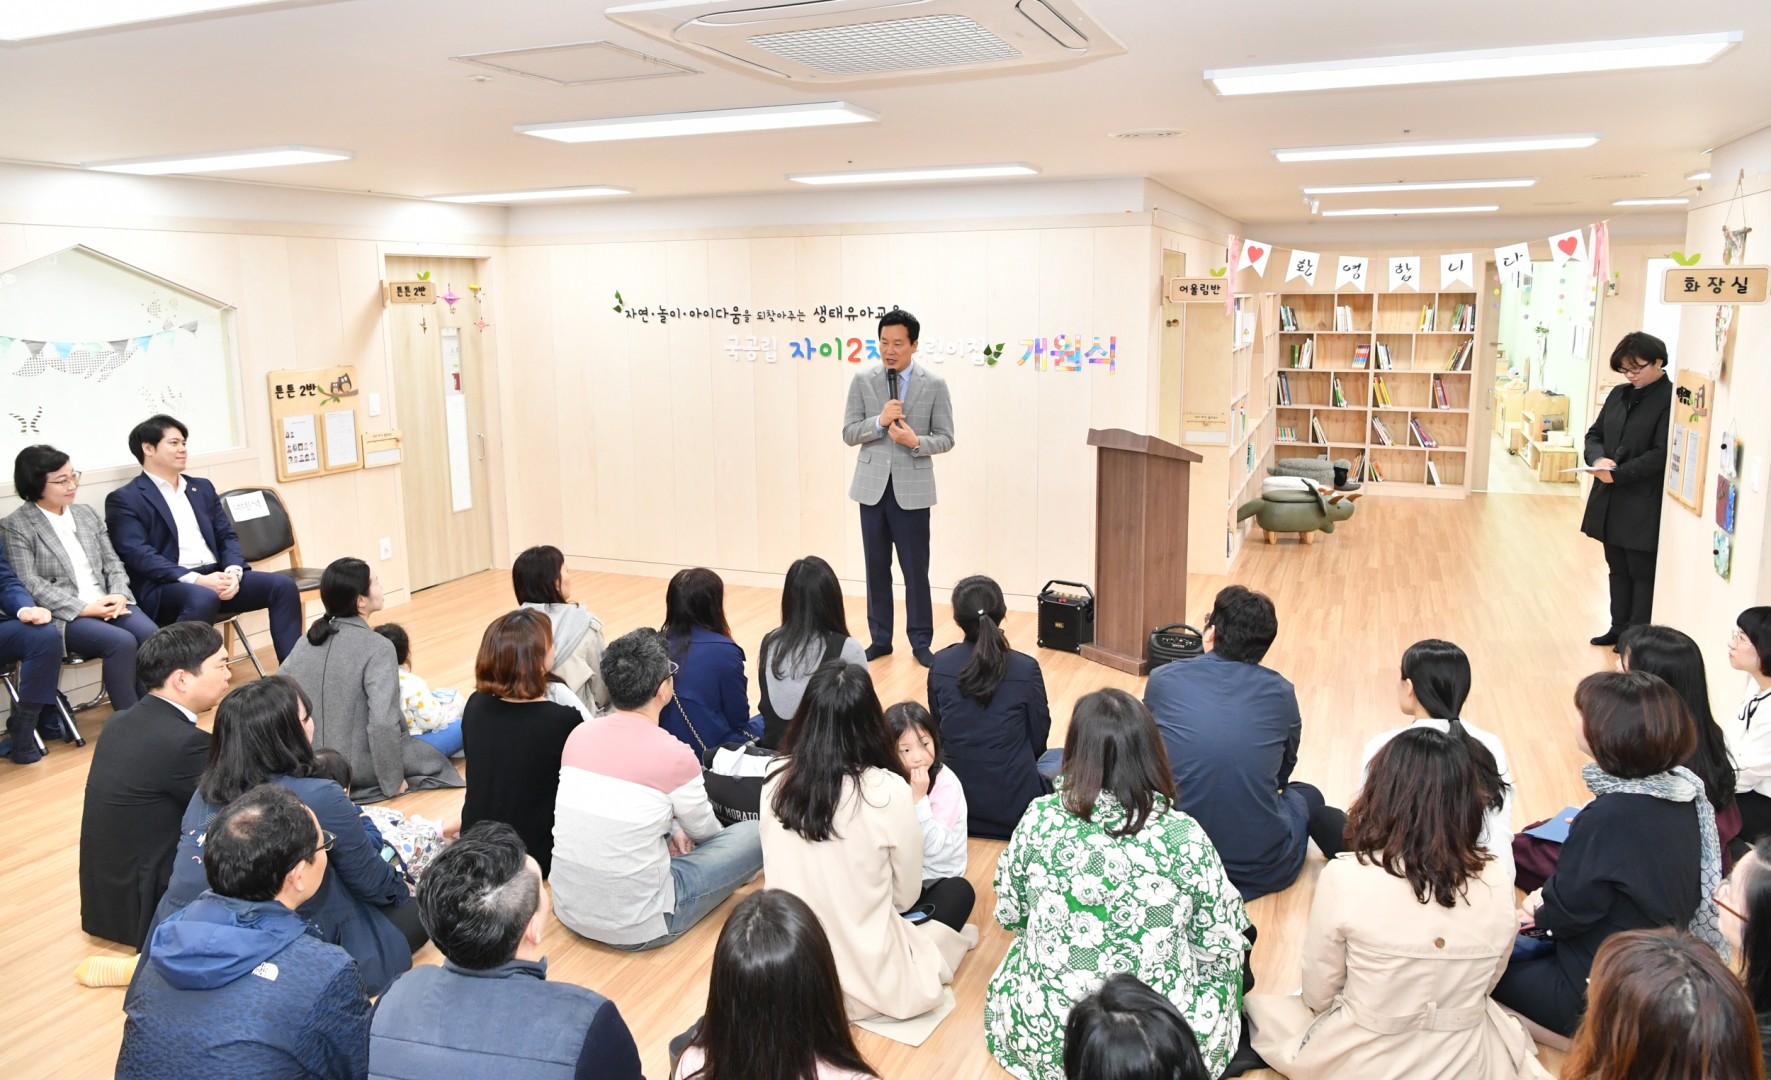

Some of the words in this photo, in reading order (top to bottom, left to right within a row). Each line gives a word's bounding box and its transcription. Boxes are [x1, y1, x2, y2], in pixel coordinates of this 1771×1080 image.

[413, 285, 426, 297] 2반
[1179, 283, 1221, 296] 어울림반
[1683, 276, 1748, 295] 화장실
[756, 309, 806, 323] 되찾아주는
[725, 334, 778, 364] 국공립
[1017, 333, 1117, 374] 개원식
[275, 383, 296, 400] 튼튼
[299, 382, 317, 397] 2반
